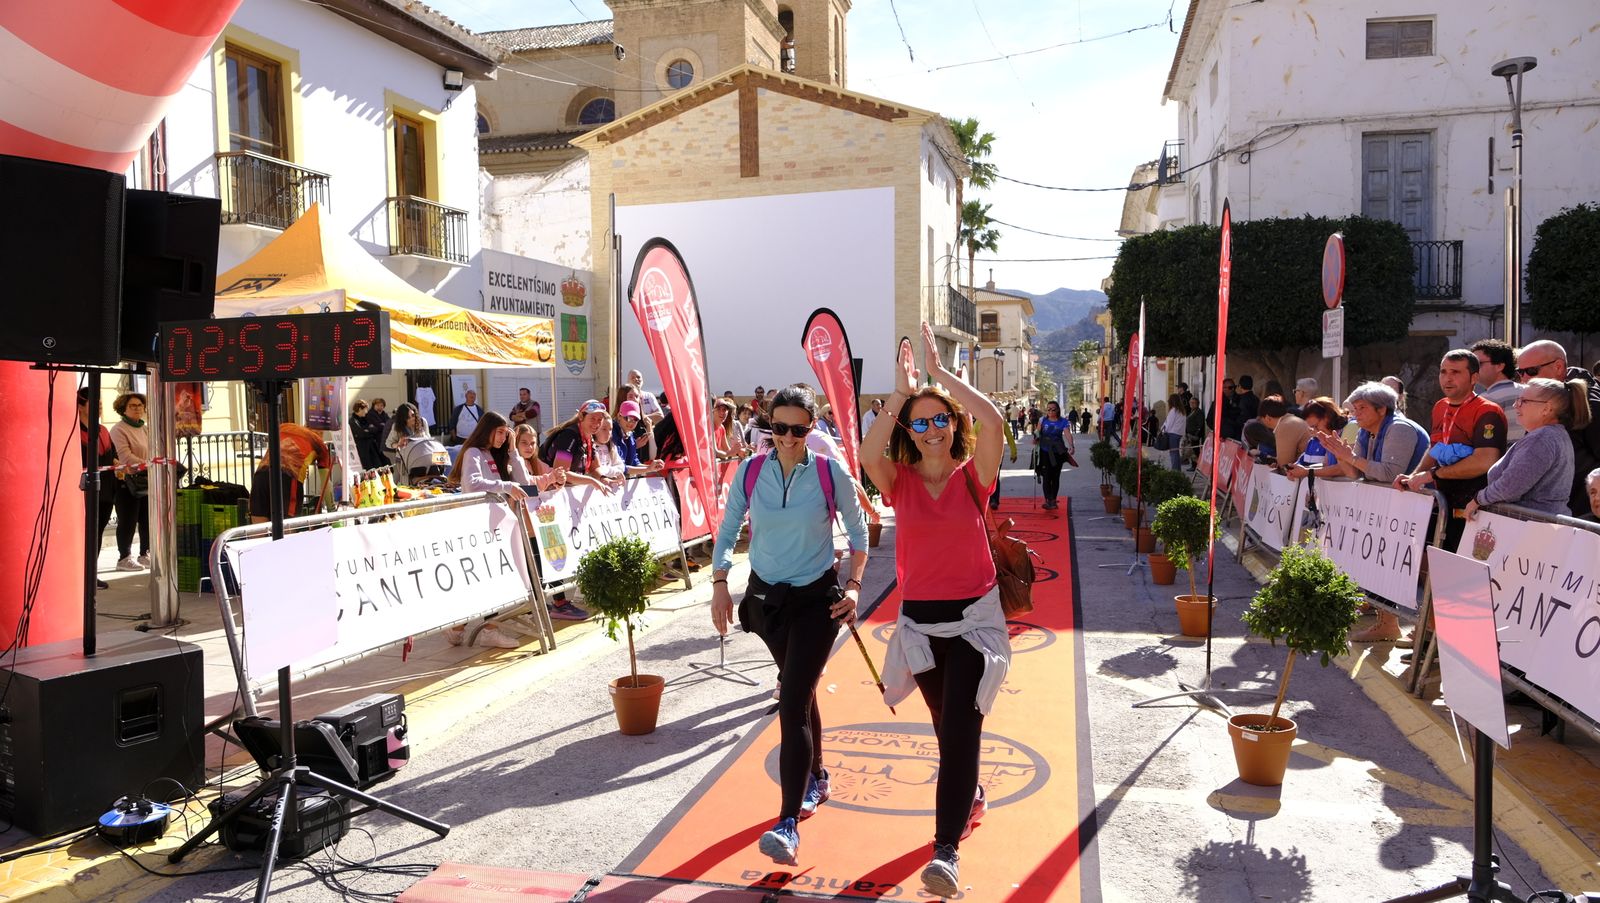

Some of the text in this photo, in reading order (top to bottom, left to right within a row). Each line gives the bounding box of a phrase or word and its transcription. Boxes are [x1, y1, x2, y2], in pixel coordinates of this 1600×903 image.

[489, 271, 556, 296] EXCELENTÍSIMO
[490, 295, 556, 317] AYUNTAMIENTO
[168, 317, 376, 375] 02:53:12
[568, 494, 666, 520] AYUNTAMENTO DE
[570, 509, 673, 550] CANTORIA
[1403, 520, 1417, 538] DE
[334, 528, 503, 579] YUNTAMIENTO DE
[839, 730, 911, 740] Cantoria
[270, 796, 286, 831] VONYX
[740, 869, 904, 898] Cantoria
